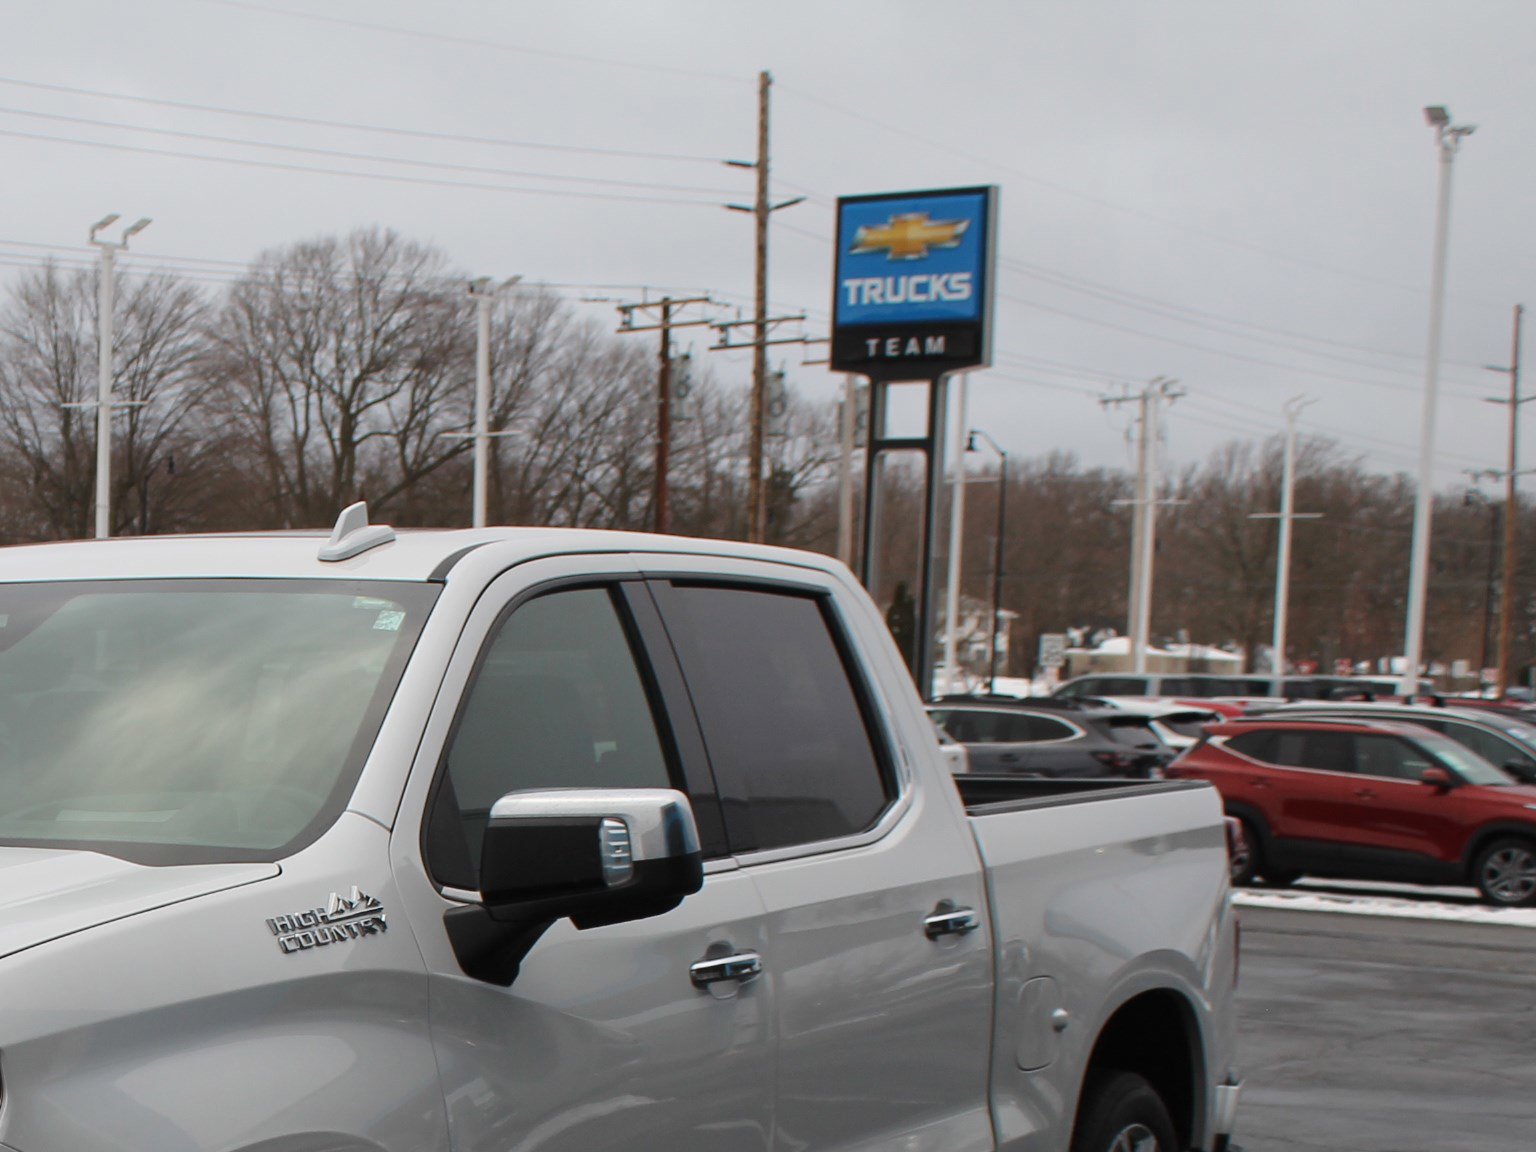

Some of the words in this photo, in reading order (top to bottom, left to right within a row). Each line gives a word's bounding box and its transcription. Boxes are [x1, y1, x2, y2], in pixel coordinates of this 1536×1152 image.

[843, 272, 972, 306] TRUCKS
[865, 335, 946, 358] TEAM
[265, 907, 330, 936] HIGH
[278, 914, 388, 954] COUNTRY
